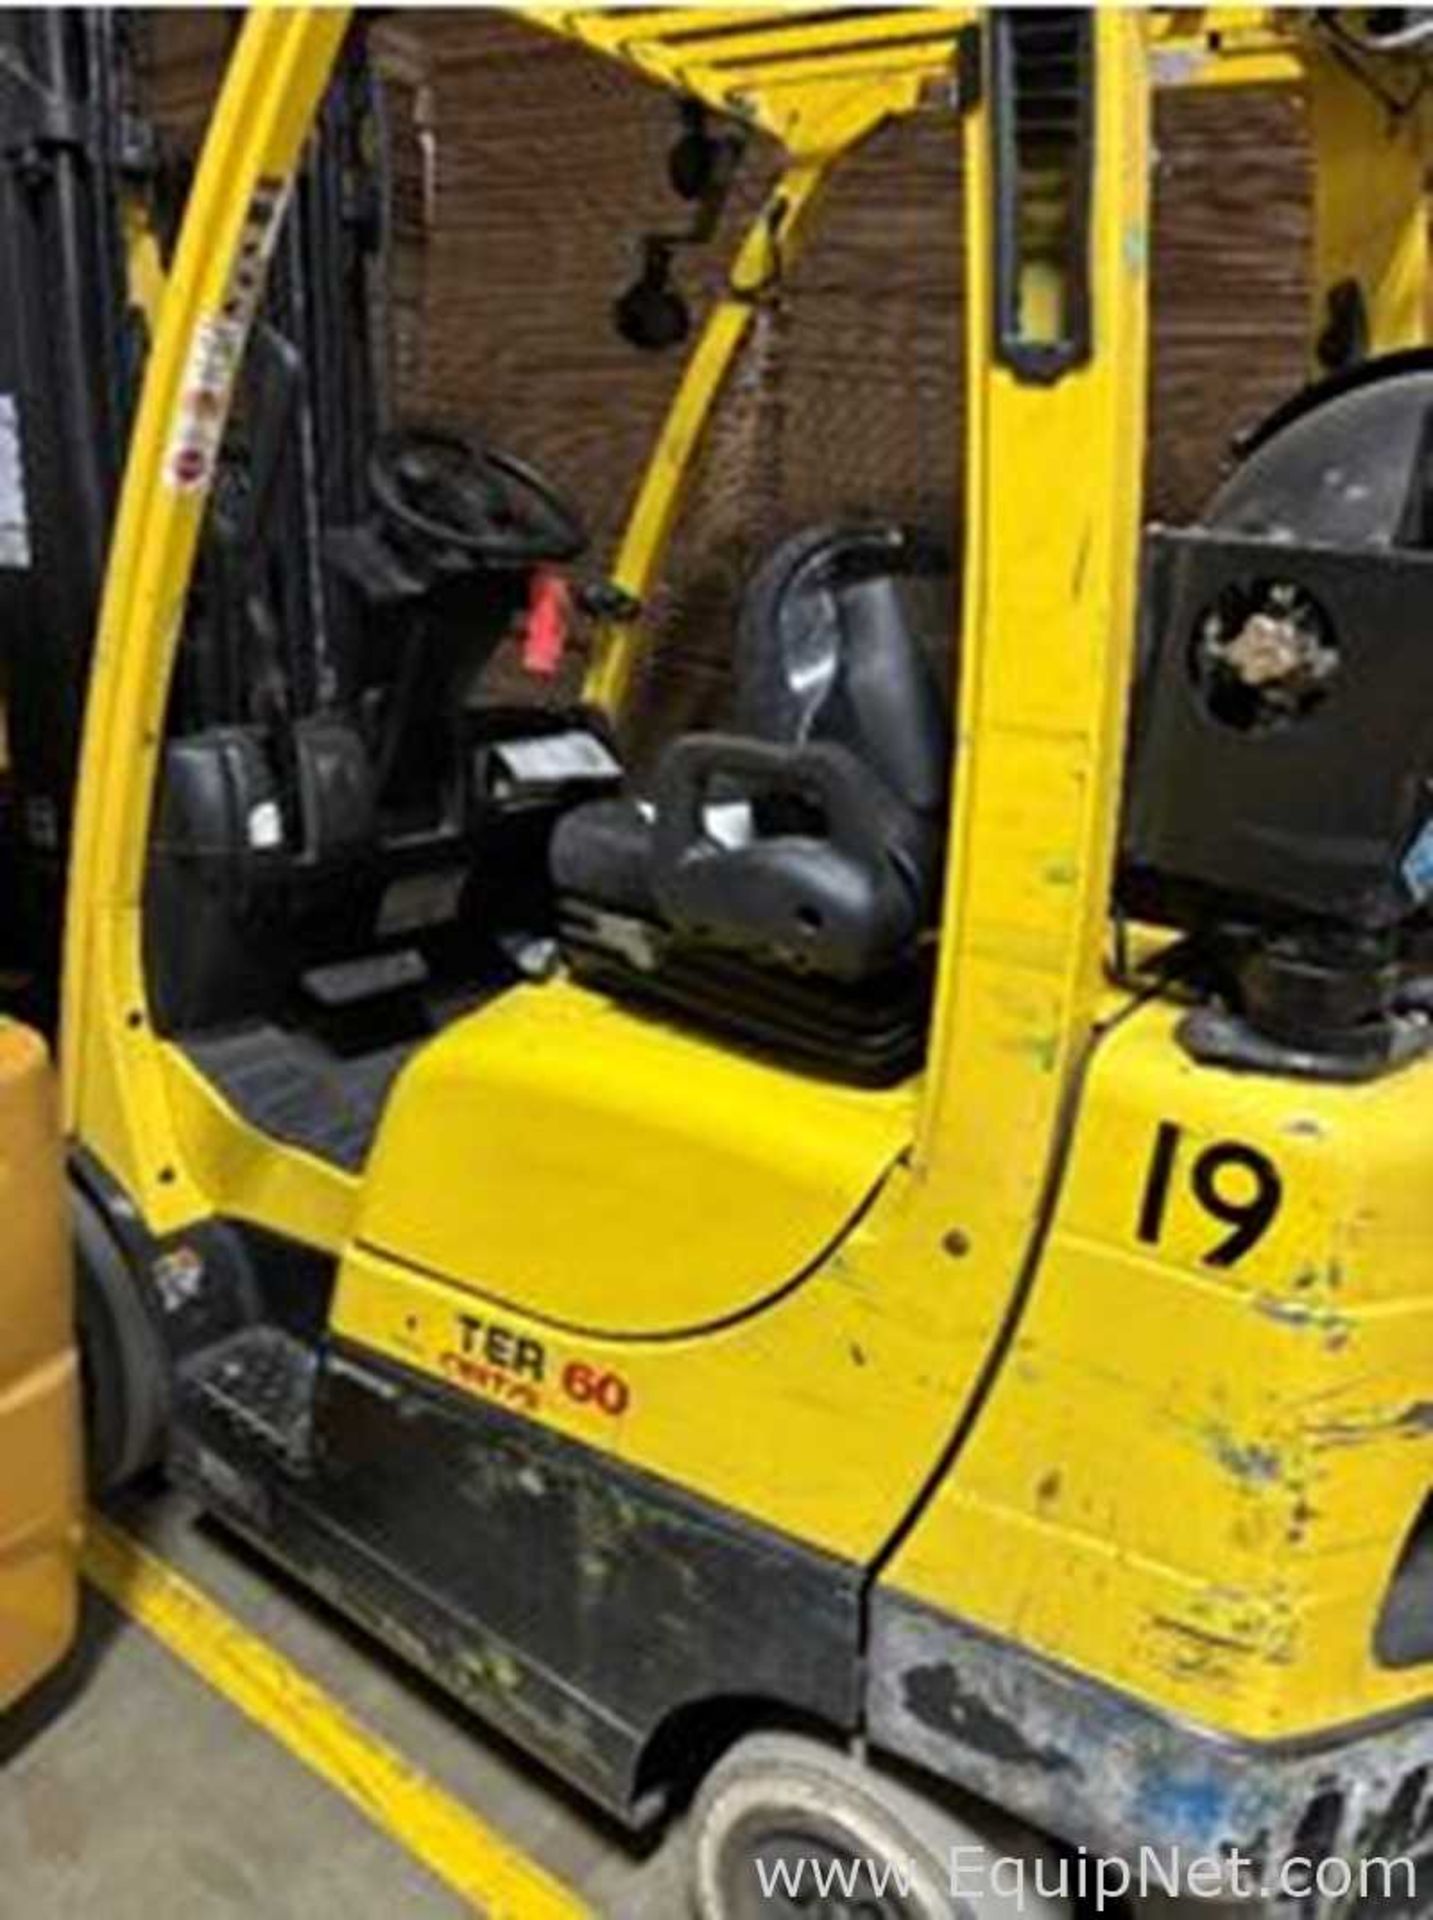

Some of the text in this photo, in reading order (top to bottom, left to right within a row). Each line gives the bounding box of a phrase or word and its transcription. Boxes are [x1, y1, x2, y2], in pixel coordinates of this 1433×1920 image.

[1137, 1120, 1283, 1269] 19
[458, 1312, 545, 1382] TER
[562, 1360, 630, 1416] 60
